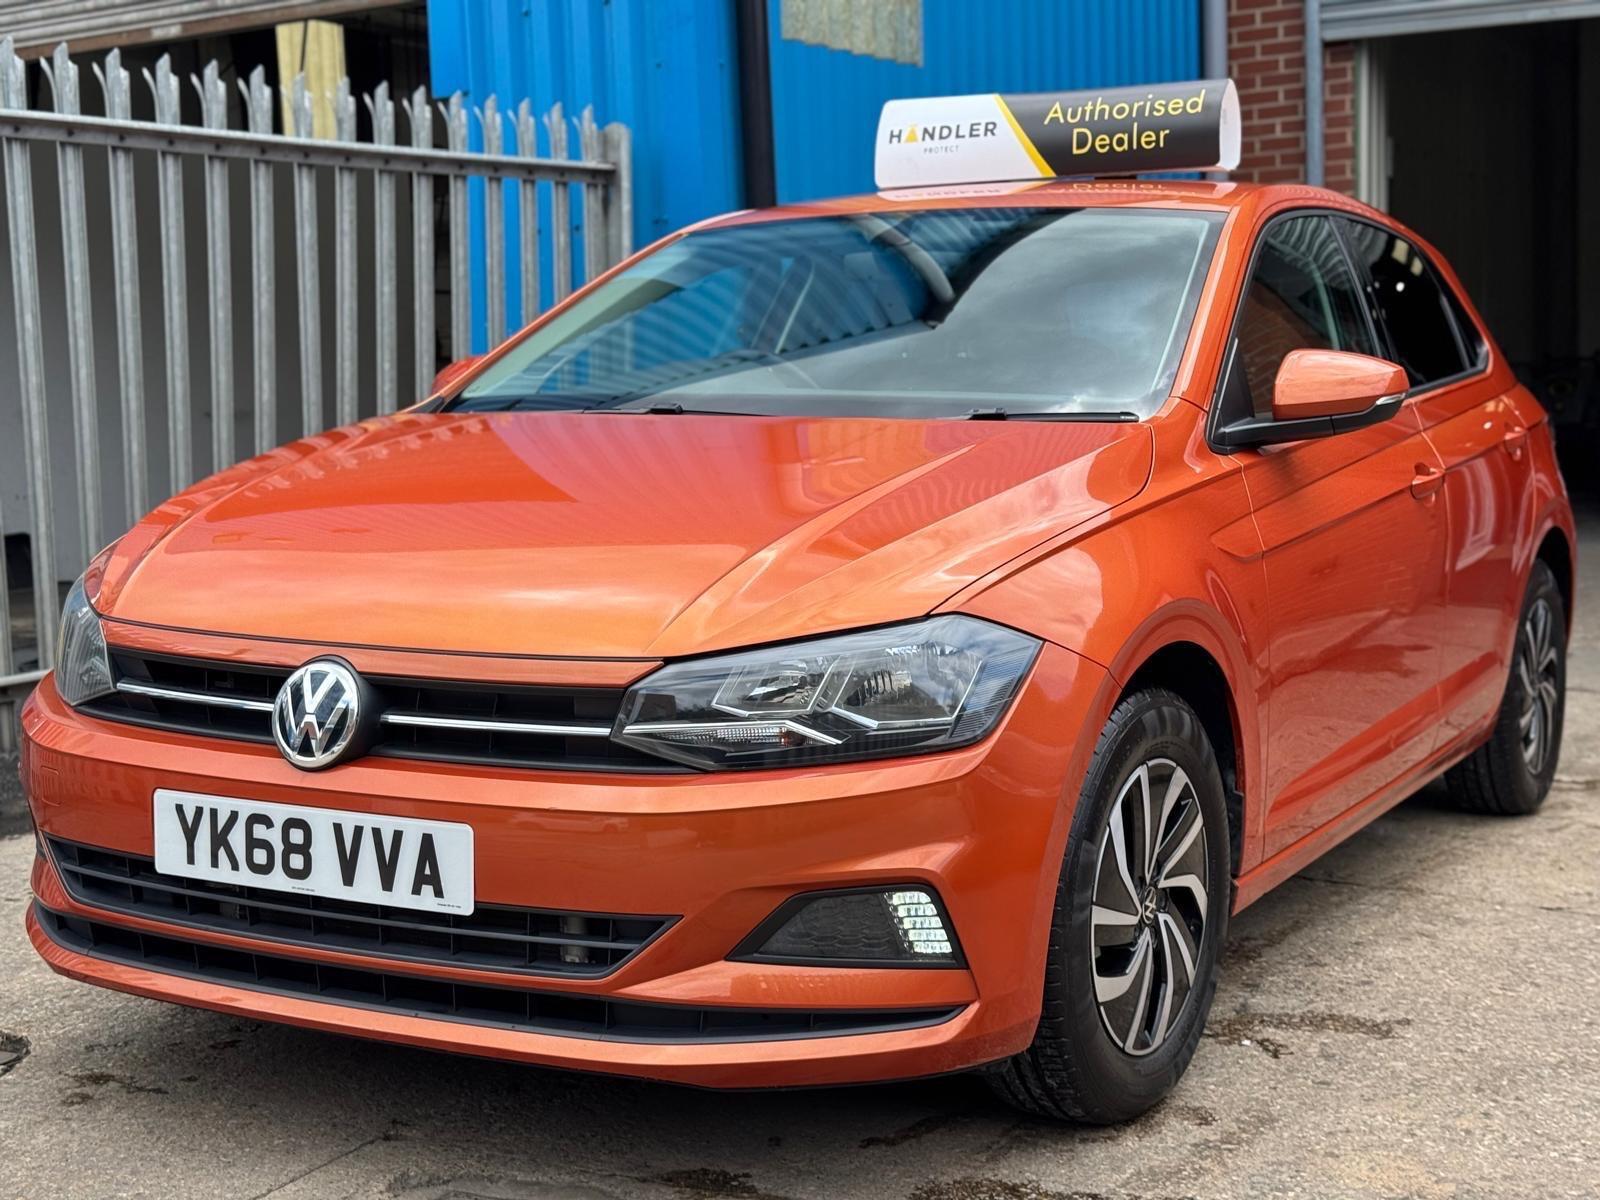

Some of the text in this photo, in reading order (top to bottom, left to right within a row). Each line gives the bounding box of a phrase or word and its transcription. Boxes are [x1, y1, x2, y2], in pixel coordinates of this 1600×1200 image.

[1043, 88, 1206, 125] Authorised
[923, 144, 960, 155] PROTECT
[1072, 122, 1171, 155] Dealer
[175, 803, 445, 899] YK68 VVA
